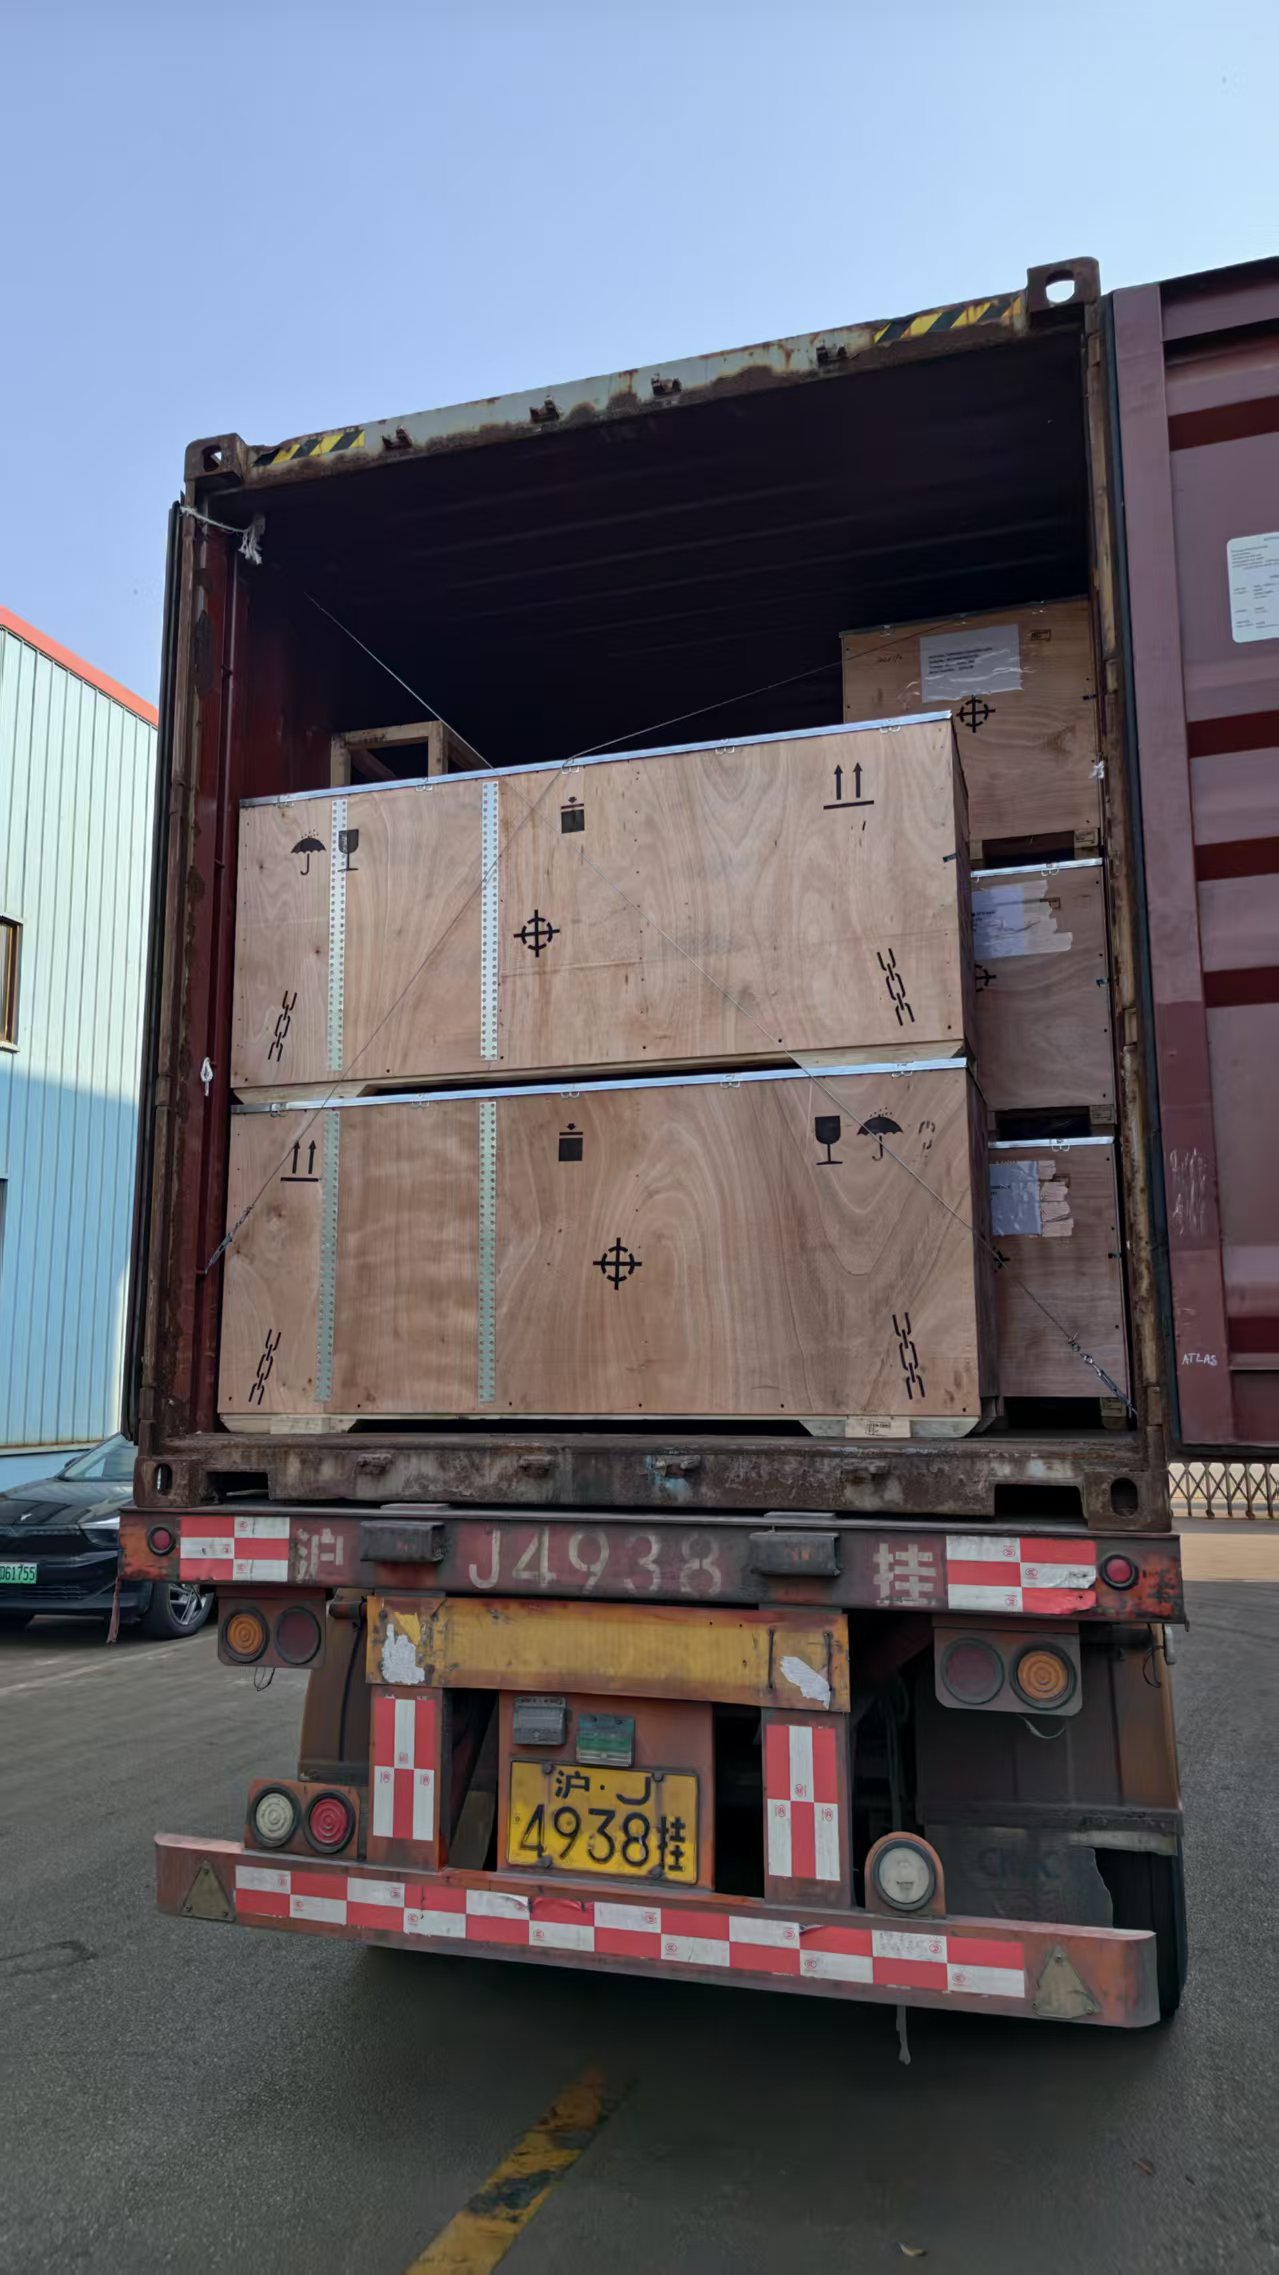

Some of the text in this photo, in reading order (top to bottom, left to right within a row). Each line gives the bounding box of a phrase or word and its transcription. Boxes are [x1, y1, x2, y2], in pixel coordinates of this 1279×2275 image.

[1182, 1352, 1217, 1367] ATLAS
[297, 1527, 936, 1607] 沪 J4938 挂
